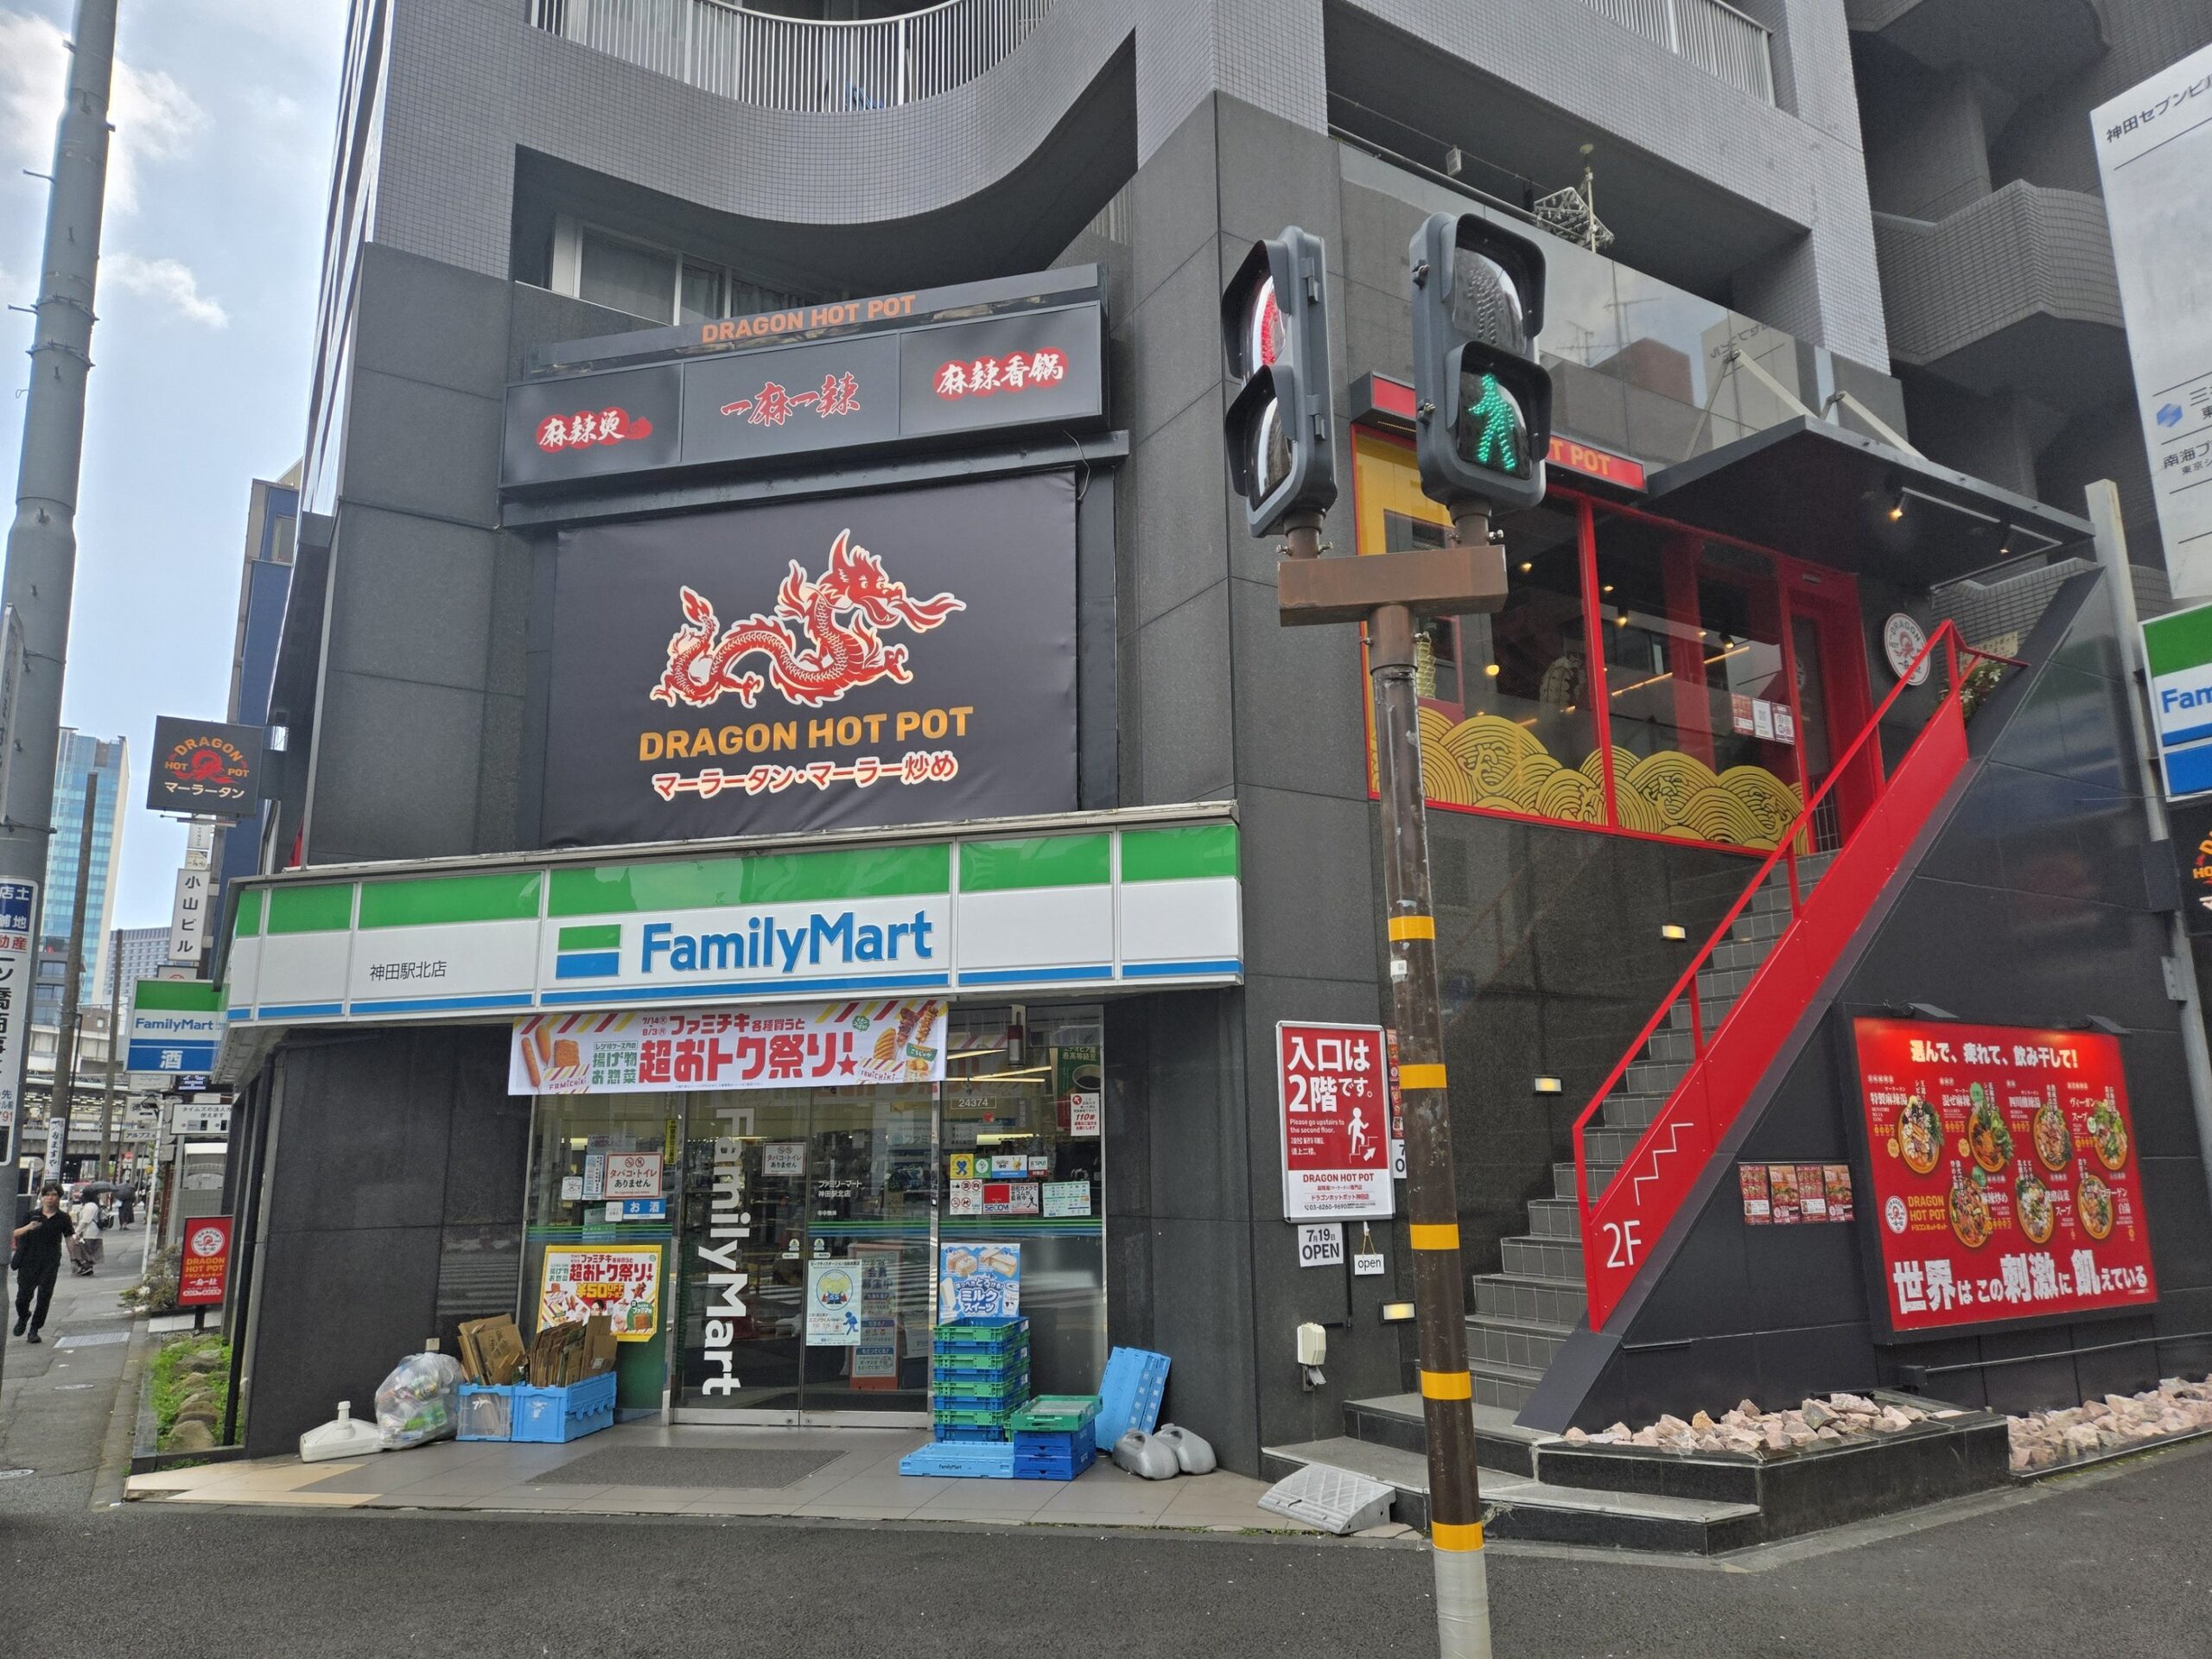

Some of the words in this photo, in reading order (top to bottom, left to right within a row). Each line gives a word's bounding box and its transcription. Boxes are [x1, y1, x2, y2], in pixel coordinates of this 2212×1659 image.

[702, 310, 804, 343] DRAGON
[810, 301, 861, 330] HOT
[868, 295, 917, 321] POT
[721, 372, 861, 427] 一麻一辣
[1571, 446, 1611, 476] POT
[639, 721, 798, 761] DRAGON
[808, 713, 887, 748] HOT
[896, 706, 974, 744] POT
[175, 736, 244, 763] DRAGON
[164, 760, 188, 771] HOT
[228, 767, 249, 778] POT
[653, 751, 958, 800] マーラータン・マーラー炒め
[164, 781, 245, 799] マーラータン
[13, 887, 29, 929] 土地
[176, 875, 200, 953] 小山ビル
[641, 909, 934, 974] FamilyMart
[370, 961, 447, 982] 神田駅北店
[136, 1018, 213, 1032] FamilyMart
[159, 1050, 183, 1070] 酒
[592, 1052, 637, 1068] 揚げ物
[1287, 1037, 1370, 1072] 入口は
[592, 1069, 637, 1084] お惣菜
[1288, 1074, 1373, 1113] 2階です。
[614, 1179, 652, 1188] ありません
[1303, 1174, 1338, 1183] DRAGON
[1908, 1195, 1944, 1207] DRAGON
[1910, 1210, 1927, 1222] HOT
[1929, 1210, 1945, 1220] POT
[1306, 1228, 1336, 1242] 7月19日
[1603, 1220, 1642, 1268] 2F
[698, 1108, 754, 1395] FamilyMart
[1302, 1243, 1339, 1260] OPEN
[1357, 1258, 1382, 1272] open
[961, 1288, 998, 1302] ミルク
[964, 1303, 995, 1313] スイーツ
